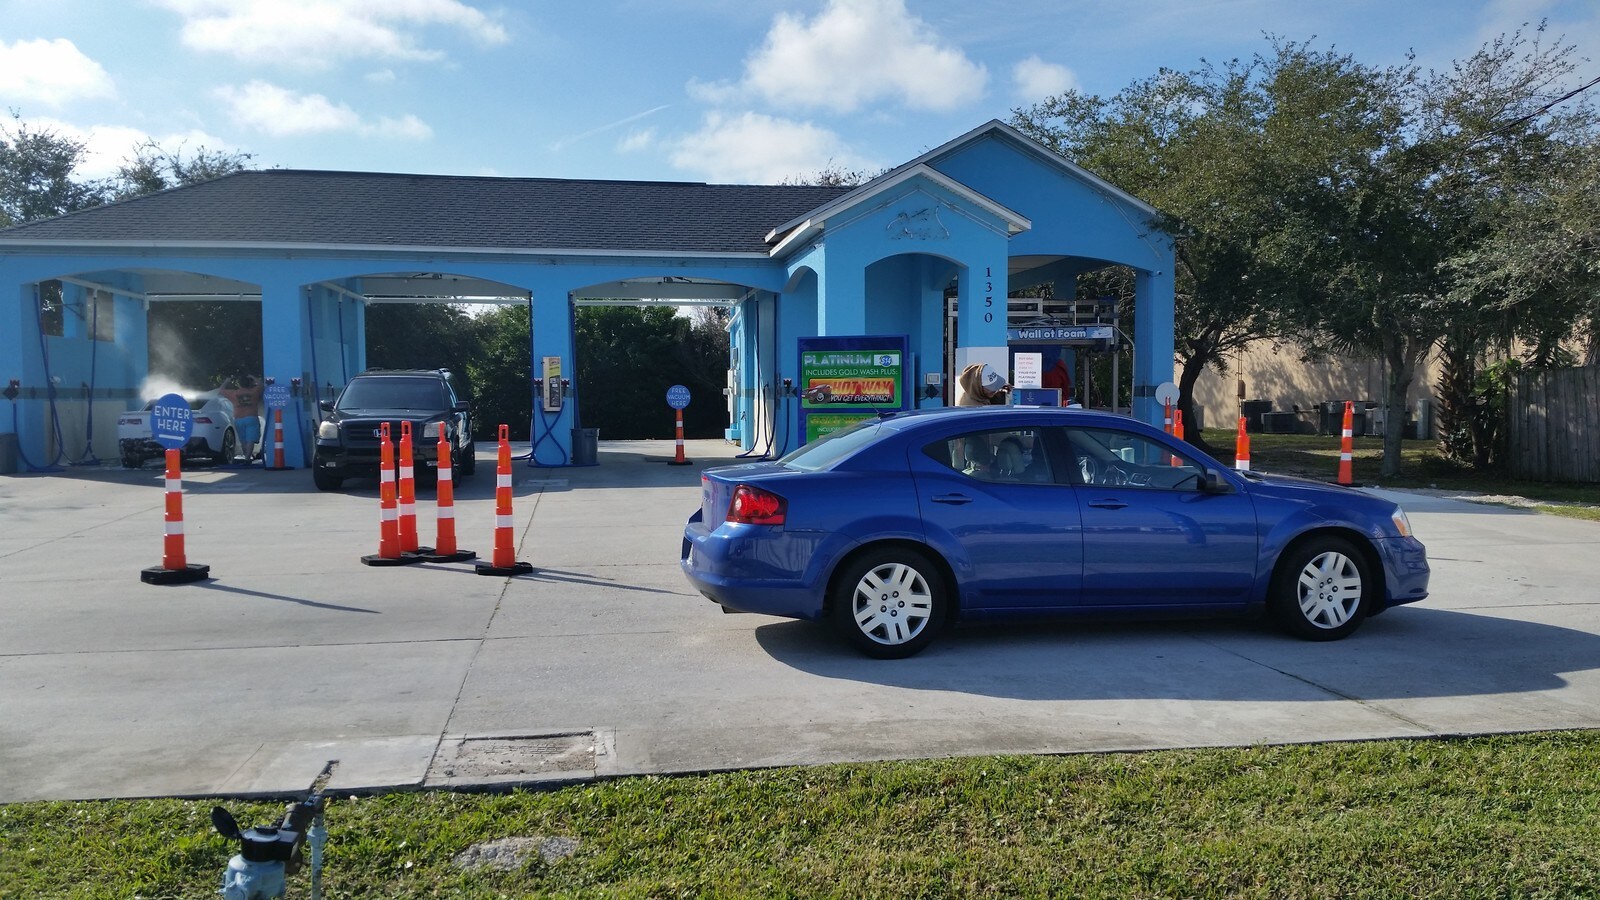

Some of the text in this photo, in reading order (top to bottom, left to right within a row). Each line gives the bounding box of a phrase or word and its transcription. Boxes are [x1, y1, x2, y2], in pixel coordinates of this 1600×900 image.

[984, 267, 993, 323] 1350
[1018, 330, 1041, 339] Wall
[1058, 329, 1087, 338] Foam
[804, 354, 872, 366] PLATINUM
[838, 368, 858, 376] GOLD
[831, 380, 891, 394] HOT WAX
[830, 394, 890, 402] YOU GET EVERYTHING!
[154, 405, 190, 420] ENTER
[157, 418, 187, 432] HERE
[810, 416, 840, 425] GOLD
